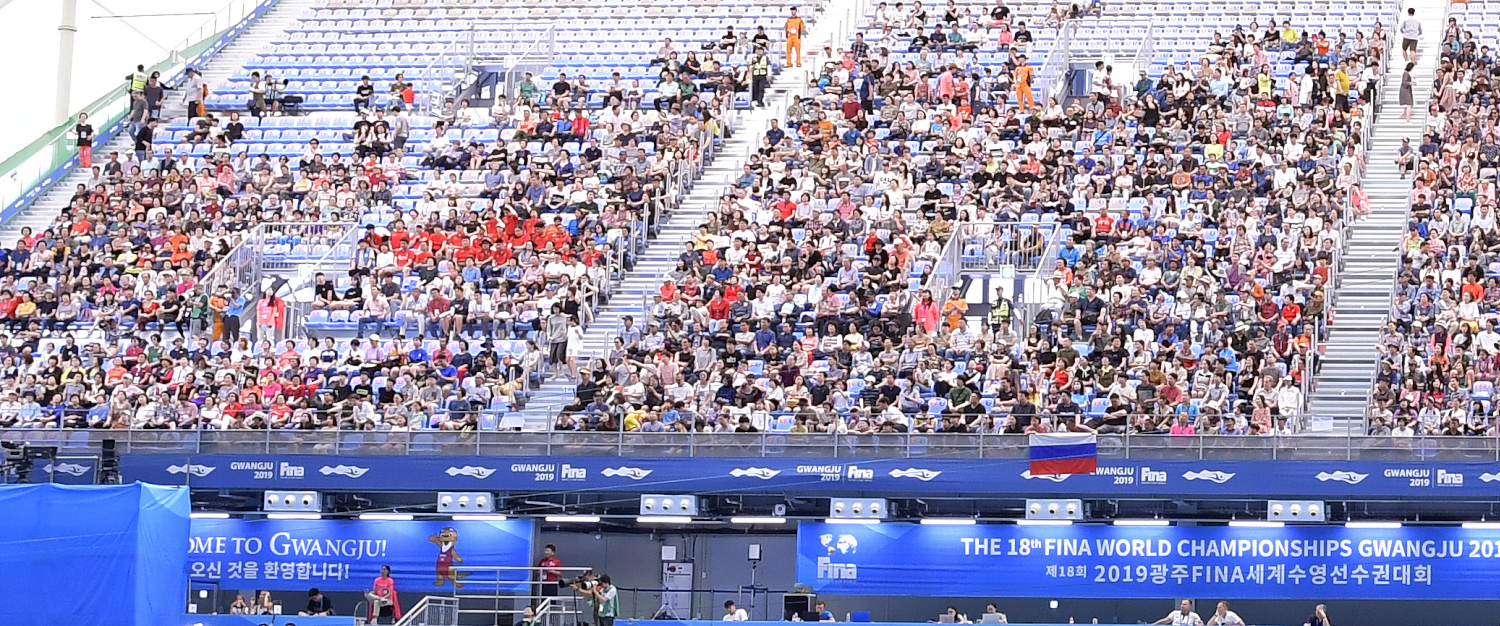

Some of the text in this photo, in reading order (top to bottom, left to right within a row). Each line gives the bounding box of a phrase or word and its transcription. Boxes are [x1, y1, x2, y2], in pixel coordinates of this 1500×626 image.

[230, 461, 274, 470] GWANGJU
[511, 463, 555, 472] GWANGJU
[796, 465, 842, 474] GWANGJU
[254, 471, 274, 480] 2019
[534, 472, 555, 481] 2019
[820, 473, 842, 481] 2019
[1383, 468, 1430, 477] GWANGJU
[1114, 476, 1134, 485] 2019
[1409, 478, 1430, 487] 2019
[231, 537, 263, 555] TO
[961, 538, 1001, 556] THE
[1007, 538, 1042, 556] 18th
[1044, 538, 1092, 557] FINA
[1096, 538, 1172, 557] WORLD
[1177, 538, 1353, 558] CHAMPIONSHIPS
[1357, 538, 1464, 558] GWANGJU
[190, 561, 350, 581] 오신 것을 환영합니다!
[1045, 563, 1432, 586] 제18회 2019광주FINA세계수영선수권대회
